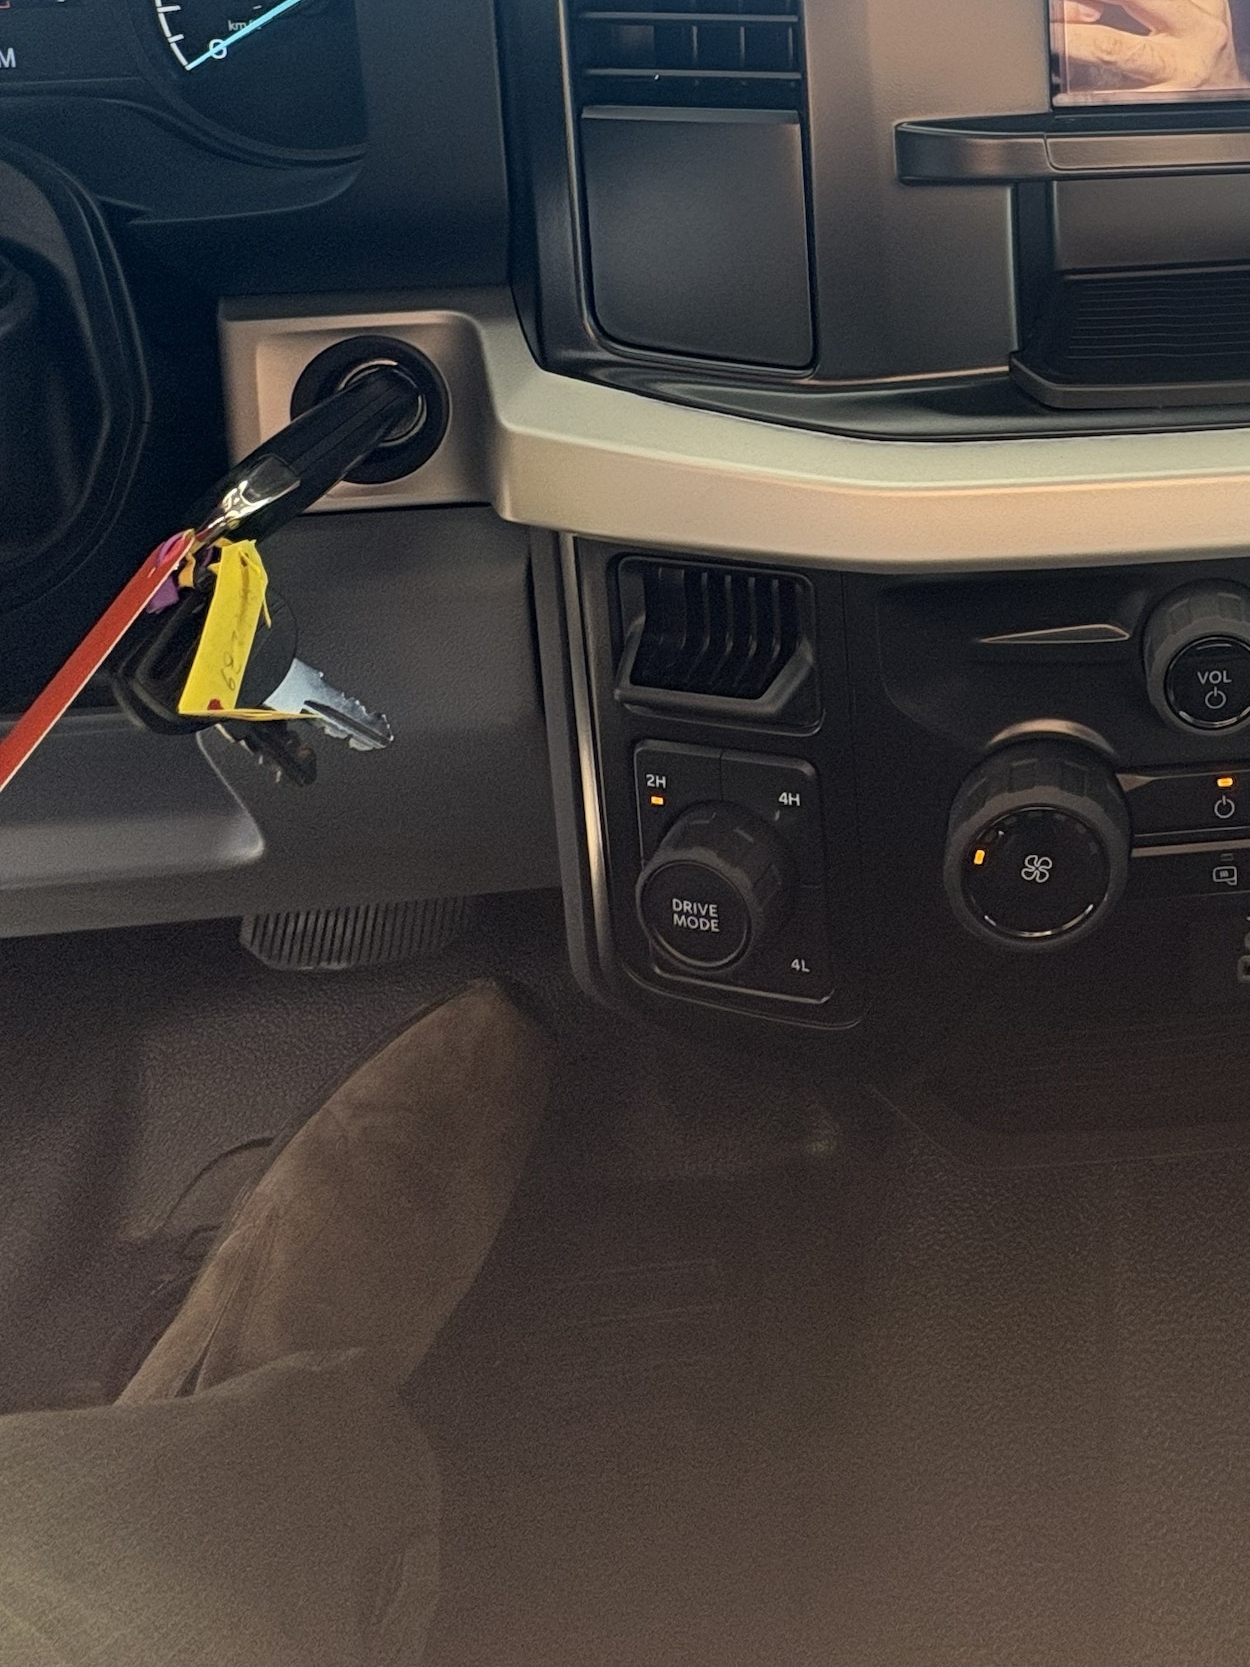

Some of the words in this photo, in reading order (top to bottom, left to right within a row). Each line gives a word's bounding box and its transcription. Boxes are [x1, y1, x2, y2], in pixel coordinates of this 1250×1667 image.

[208, 38, 228, 60] 0
[1196, 669, 1233, 685] VOL
[645, 774, 667, 789] 2H
[778, 791, 801, 807] 4H
[672, 897, 719, 918] DRIVE
[673, 913, 720, 933] MODE
[790, 958, 811, 973] 4L
